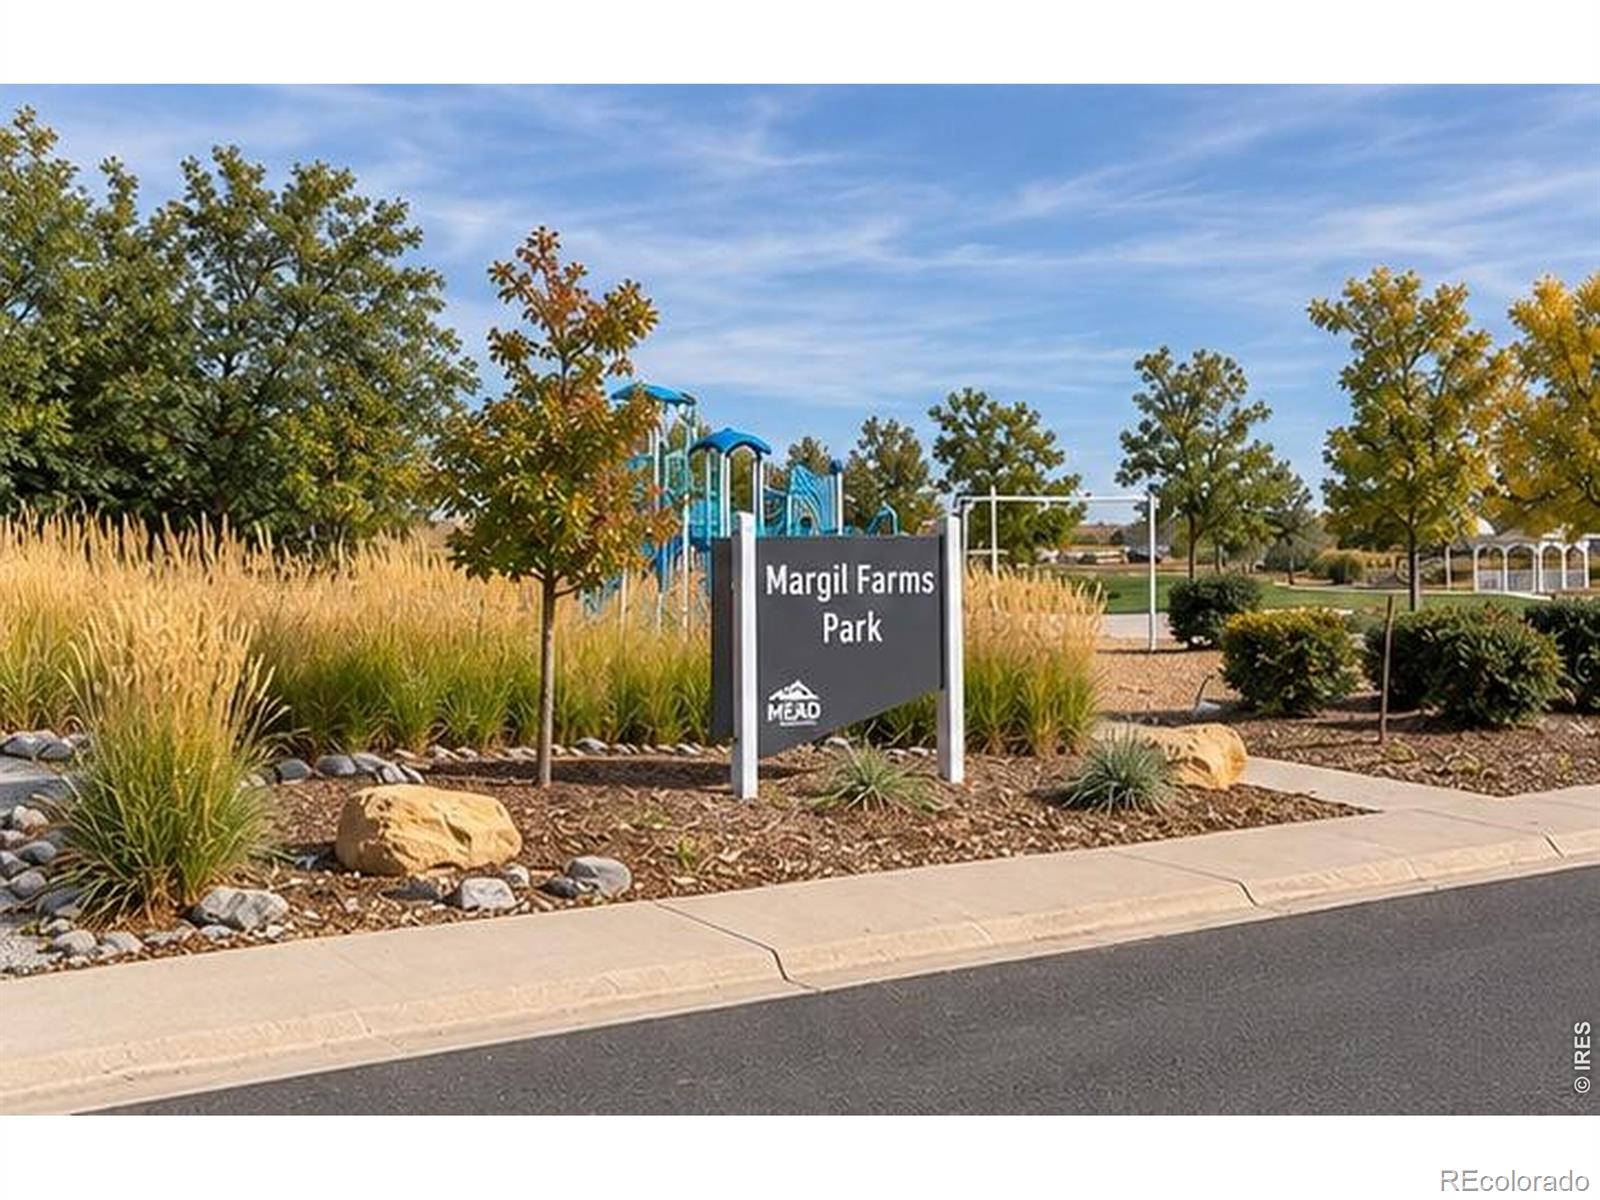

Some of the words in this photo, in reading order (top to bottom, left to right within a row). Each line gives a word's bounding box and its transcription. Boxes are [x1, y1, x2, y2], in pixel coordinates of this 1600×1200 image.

[766, 563, 848, 602] Margil
[857, 564, 935, 595] Farms
[823, 610, 883, 644] Park
[767, 701, 821, 722] MEAD
